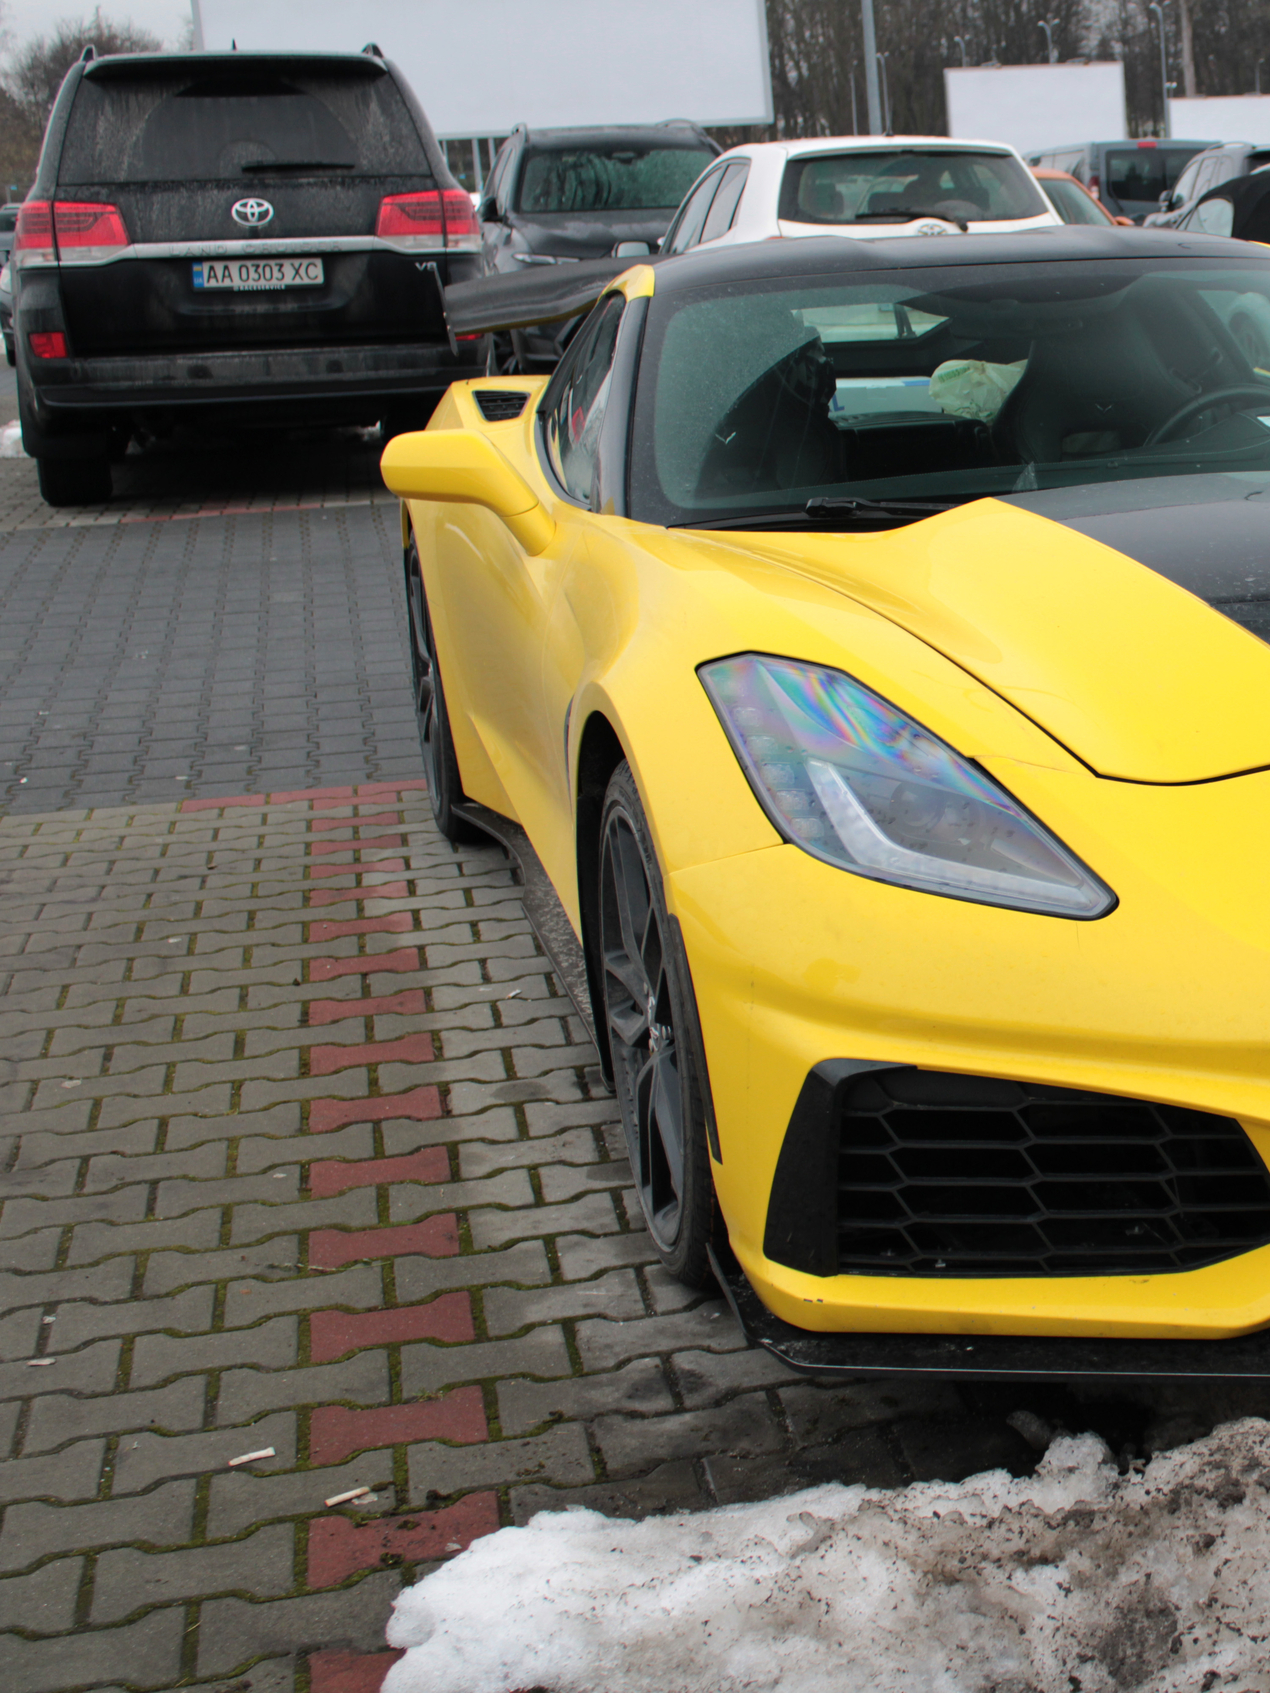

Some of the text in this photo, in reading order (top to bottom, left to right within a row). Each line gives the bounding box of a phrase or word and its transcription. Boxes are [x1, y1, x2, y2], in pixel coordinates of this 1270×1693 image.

[168, 239, 343, 257] LAND CRUISER
[206, 262, 319, 284] AA 0303 XC
